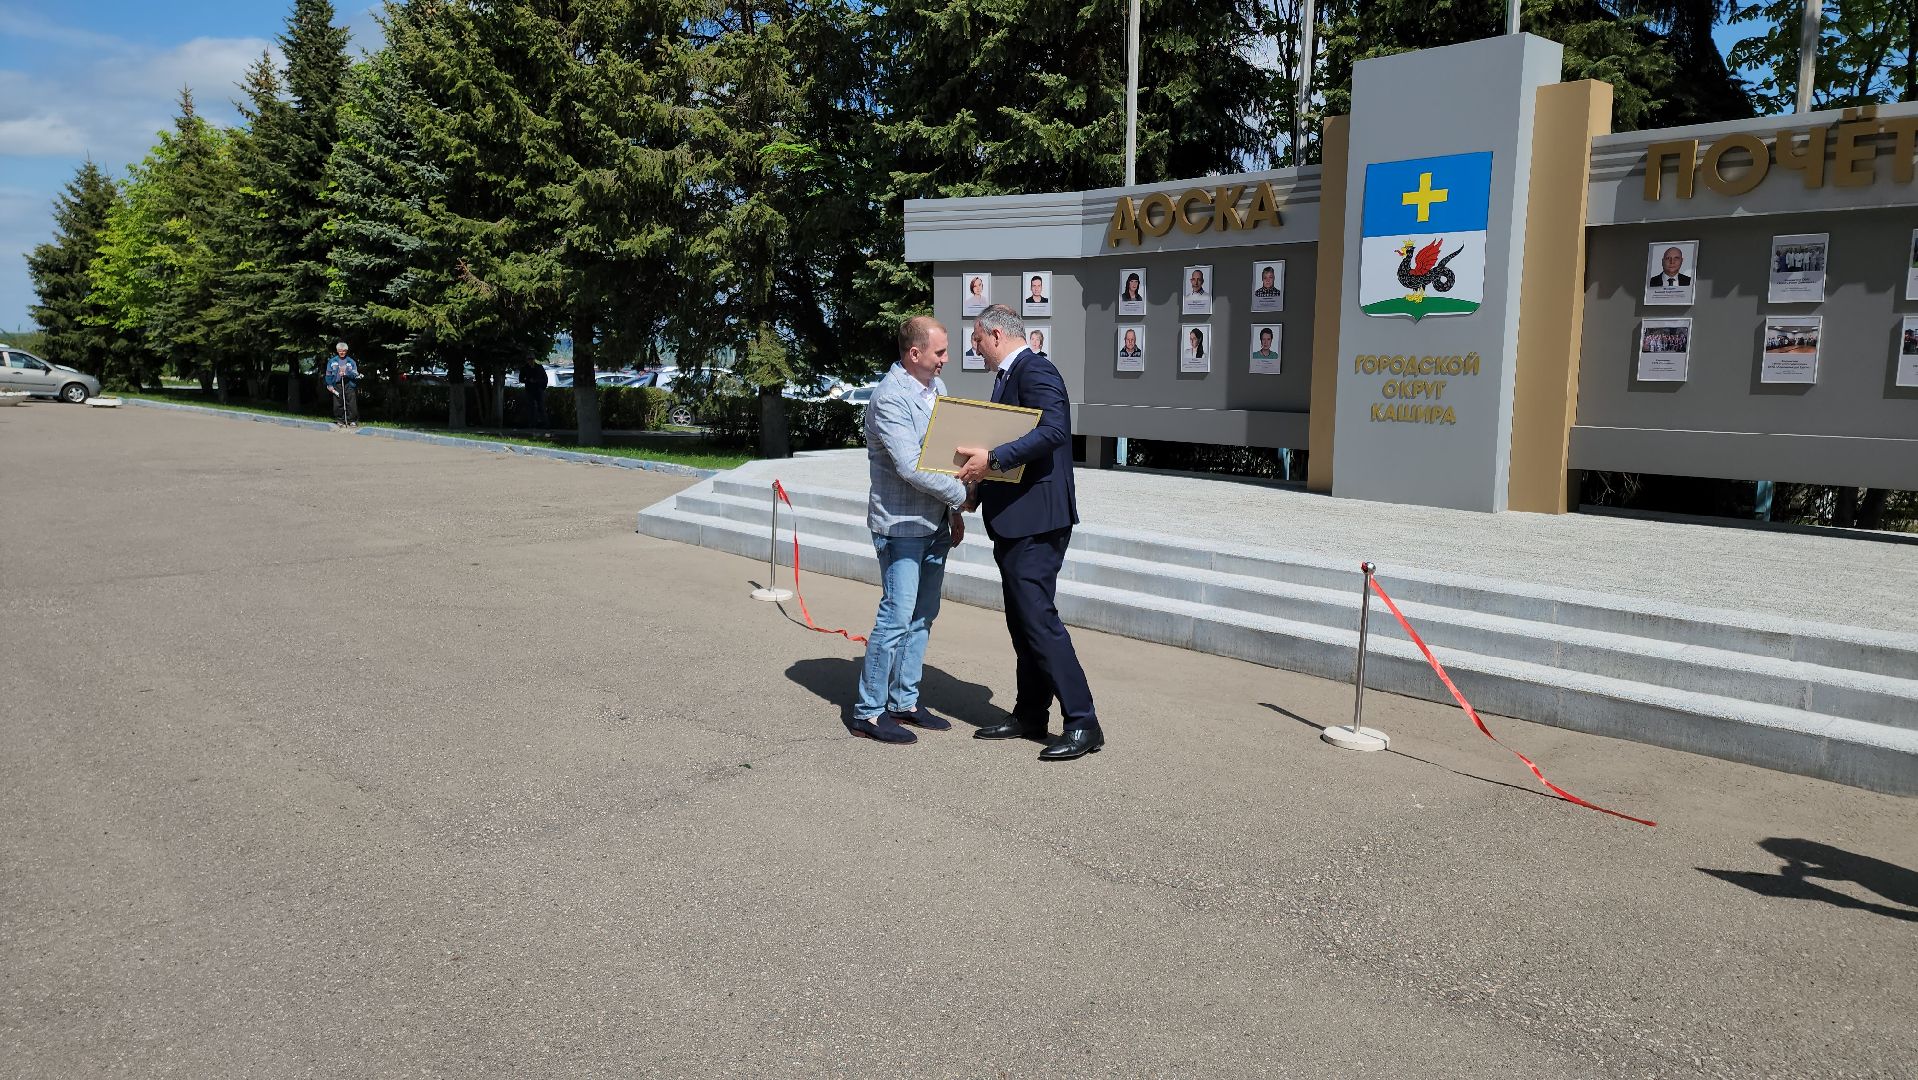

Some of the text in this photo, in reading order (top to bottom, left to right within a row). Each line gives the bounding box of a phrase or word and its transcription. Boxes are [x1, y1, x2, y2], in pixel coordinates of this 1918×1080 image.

[1108, 181, 1283, 248] ДОСКА
[1354, 351, 1480, 378] ГОРОДСКОЙ
[1382, 379, 1447, 400] ОКРУГ
[1370, 403, 1456, 425] КАШИРА
